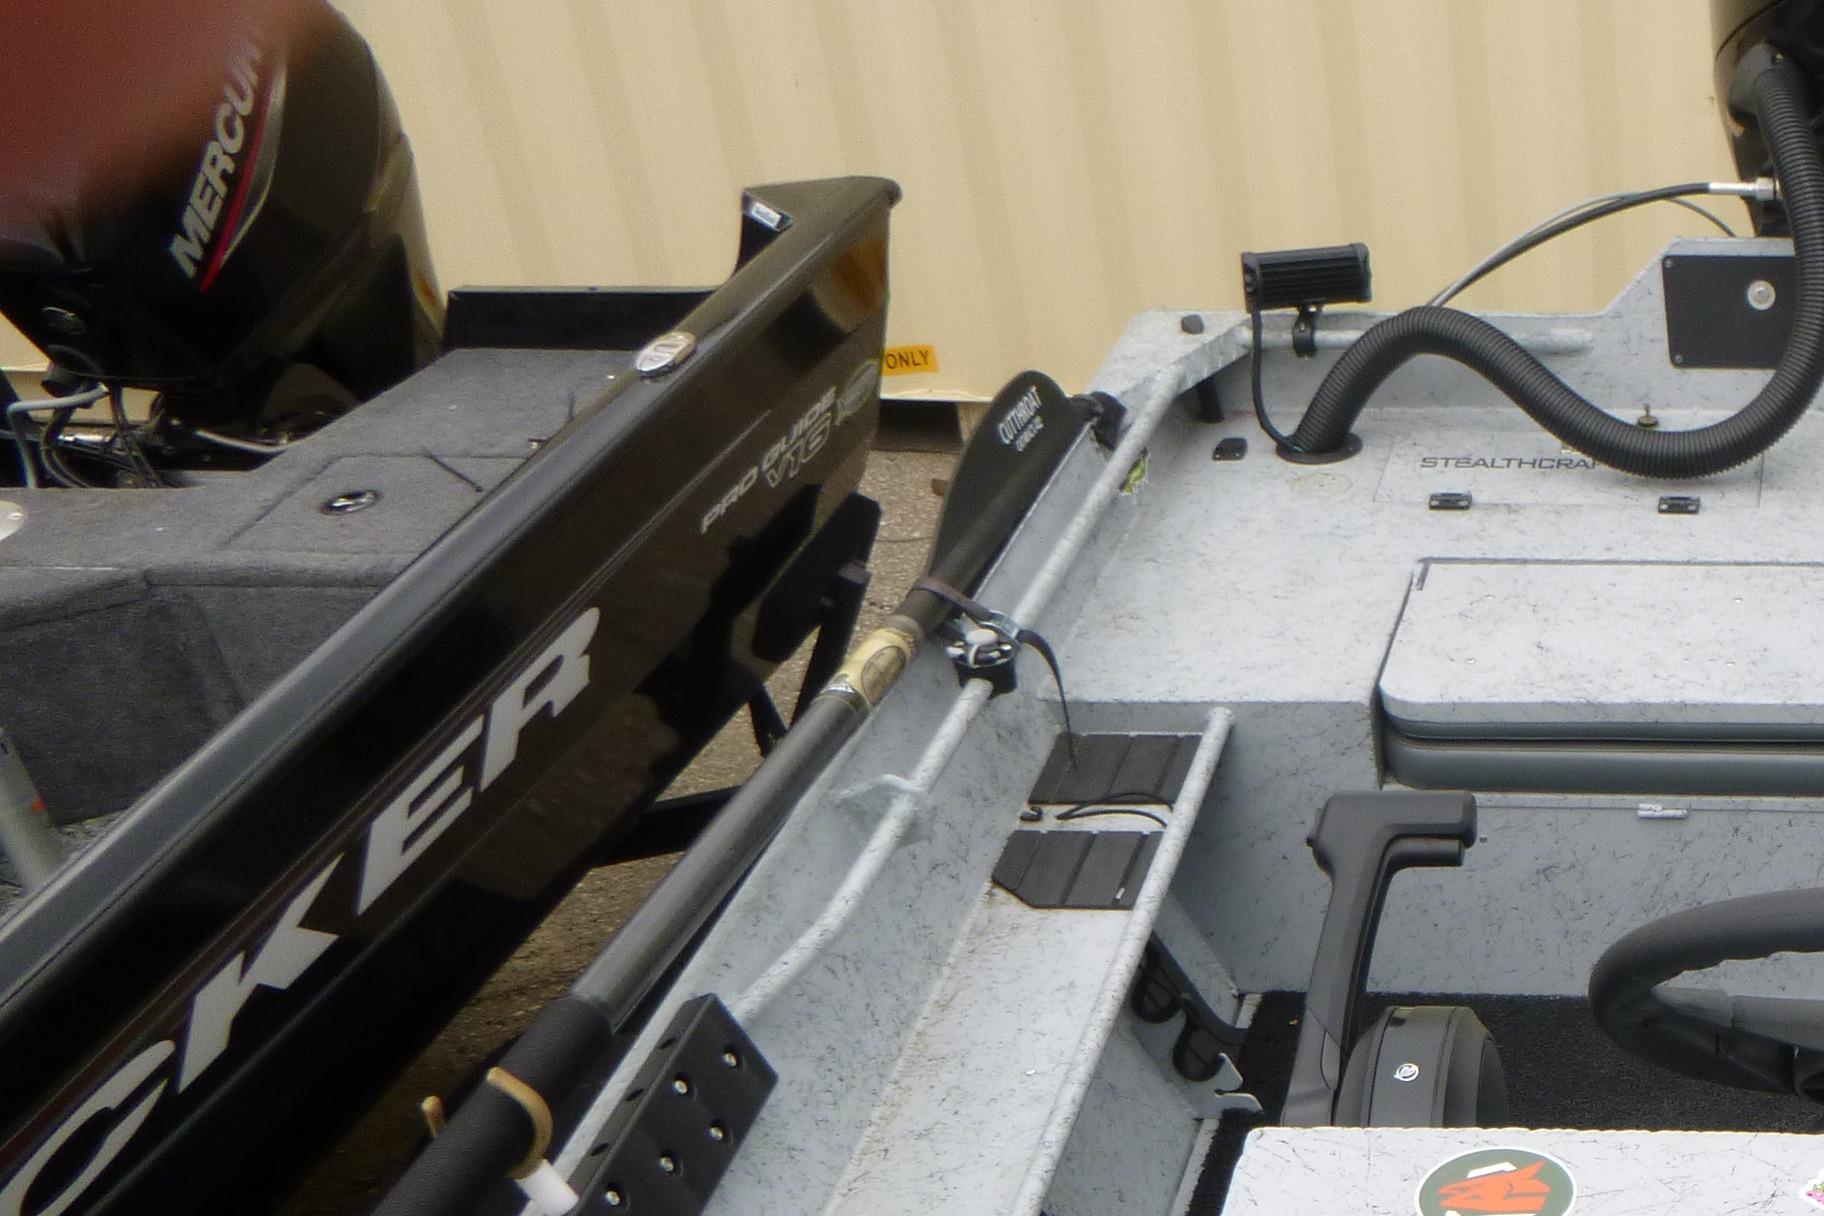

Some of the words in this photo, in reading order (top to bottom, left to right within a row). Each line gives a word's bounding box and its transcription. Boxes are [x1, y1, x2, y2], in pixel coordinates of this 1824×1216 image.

[170, 42, 261, 280] MERCUR
[884, 350, 930, 370] ONLY
[998, 384, 1043, 445] CUTTHROAT
[1420, 456, 1597, 469] STEALTHCRA
[701, 465, 759, 534] PRO
